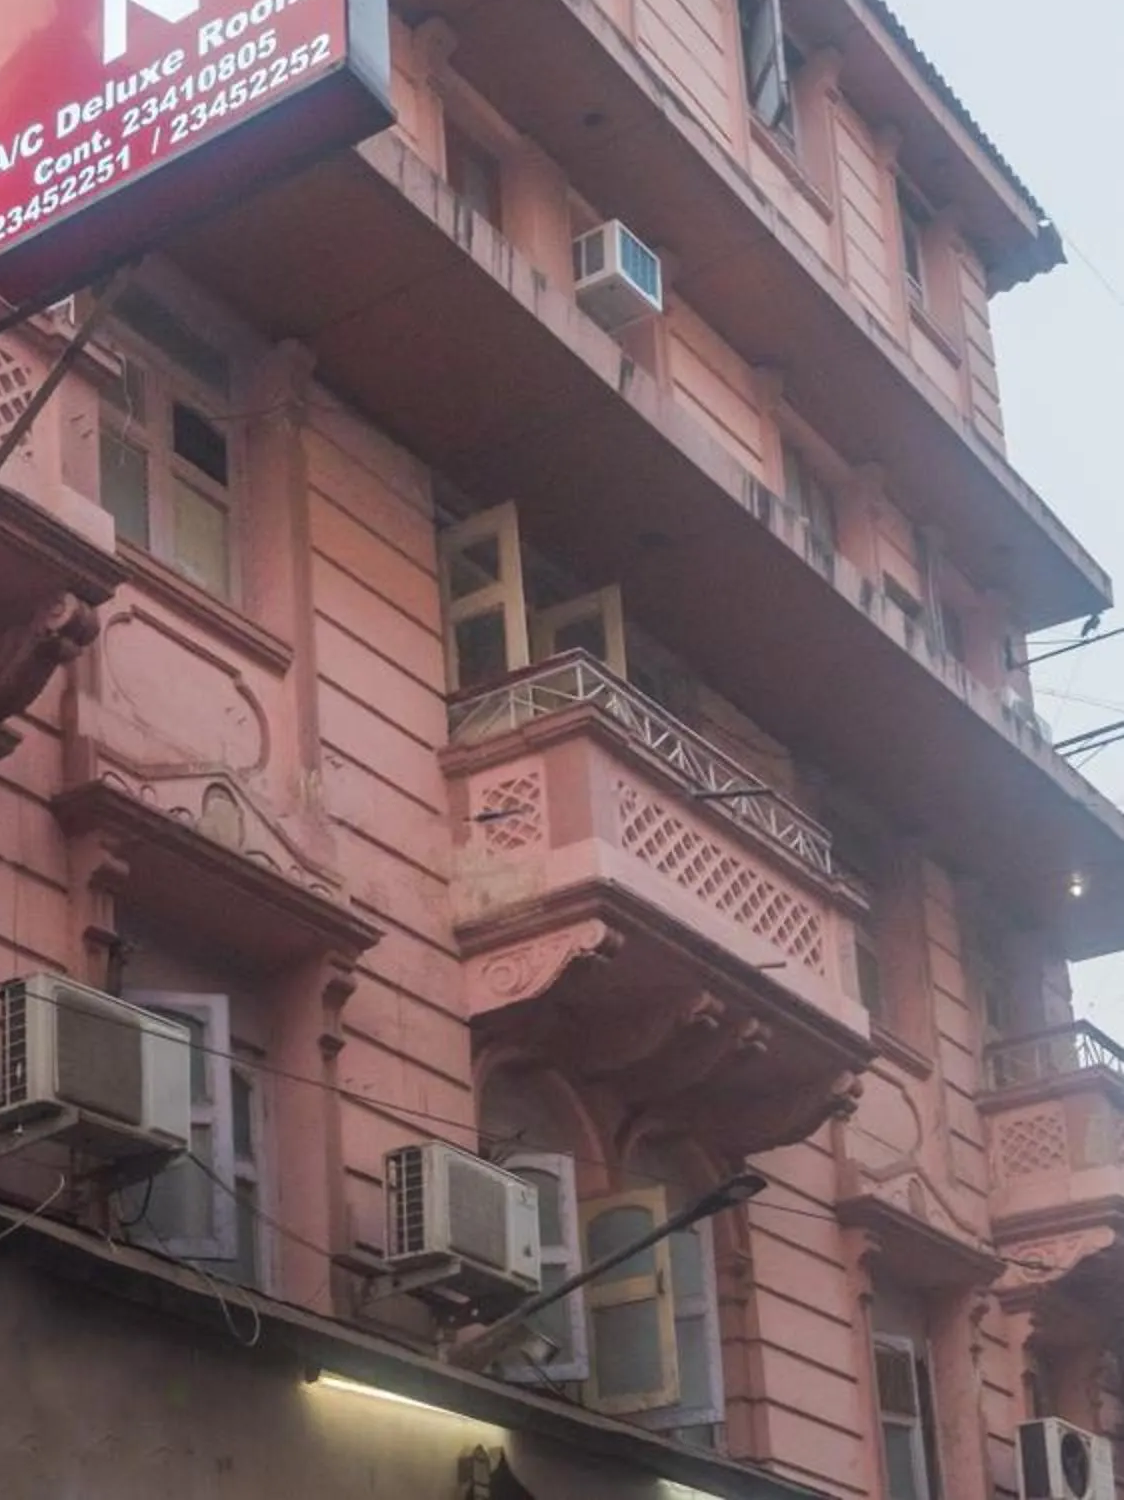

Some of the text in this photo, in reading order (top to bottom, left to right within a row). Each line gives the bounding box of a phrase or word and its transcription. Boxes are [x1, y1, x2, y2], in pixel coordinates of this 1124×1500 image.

[33, 28, 277, 186] Cont. 23410805
[57, 48, 185, 140] Deluxe
[170, 33, 331, 144] 23452252
